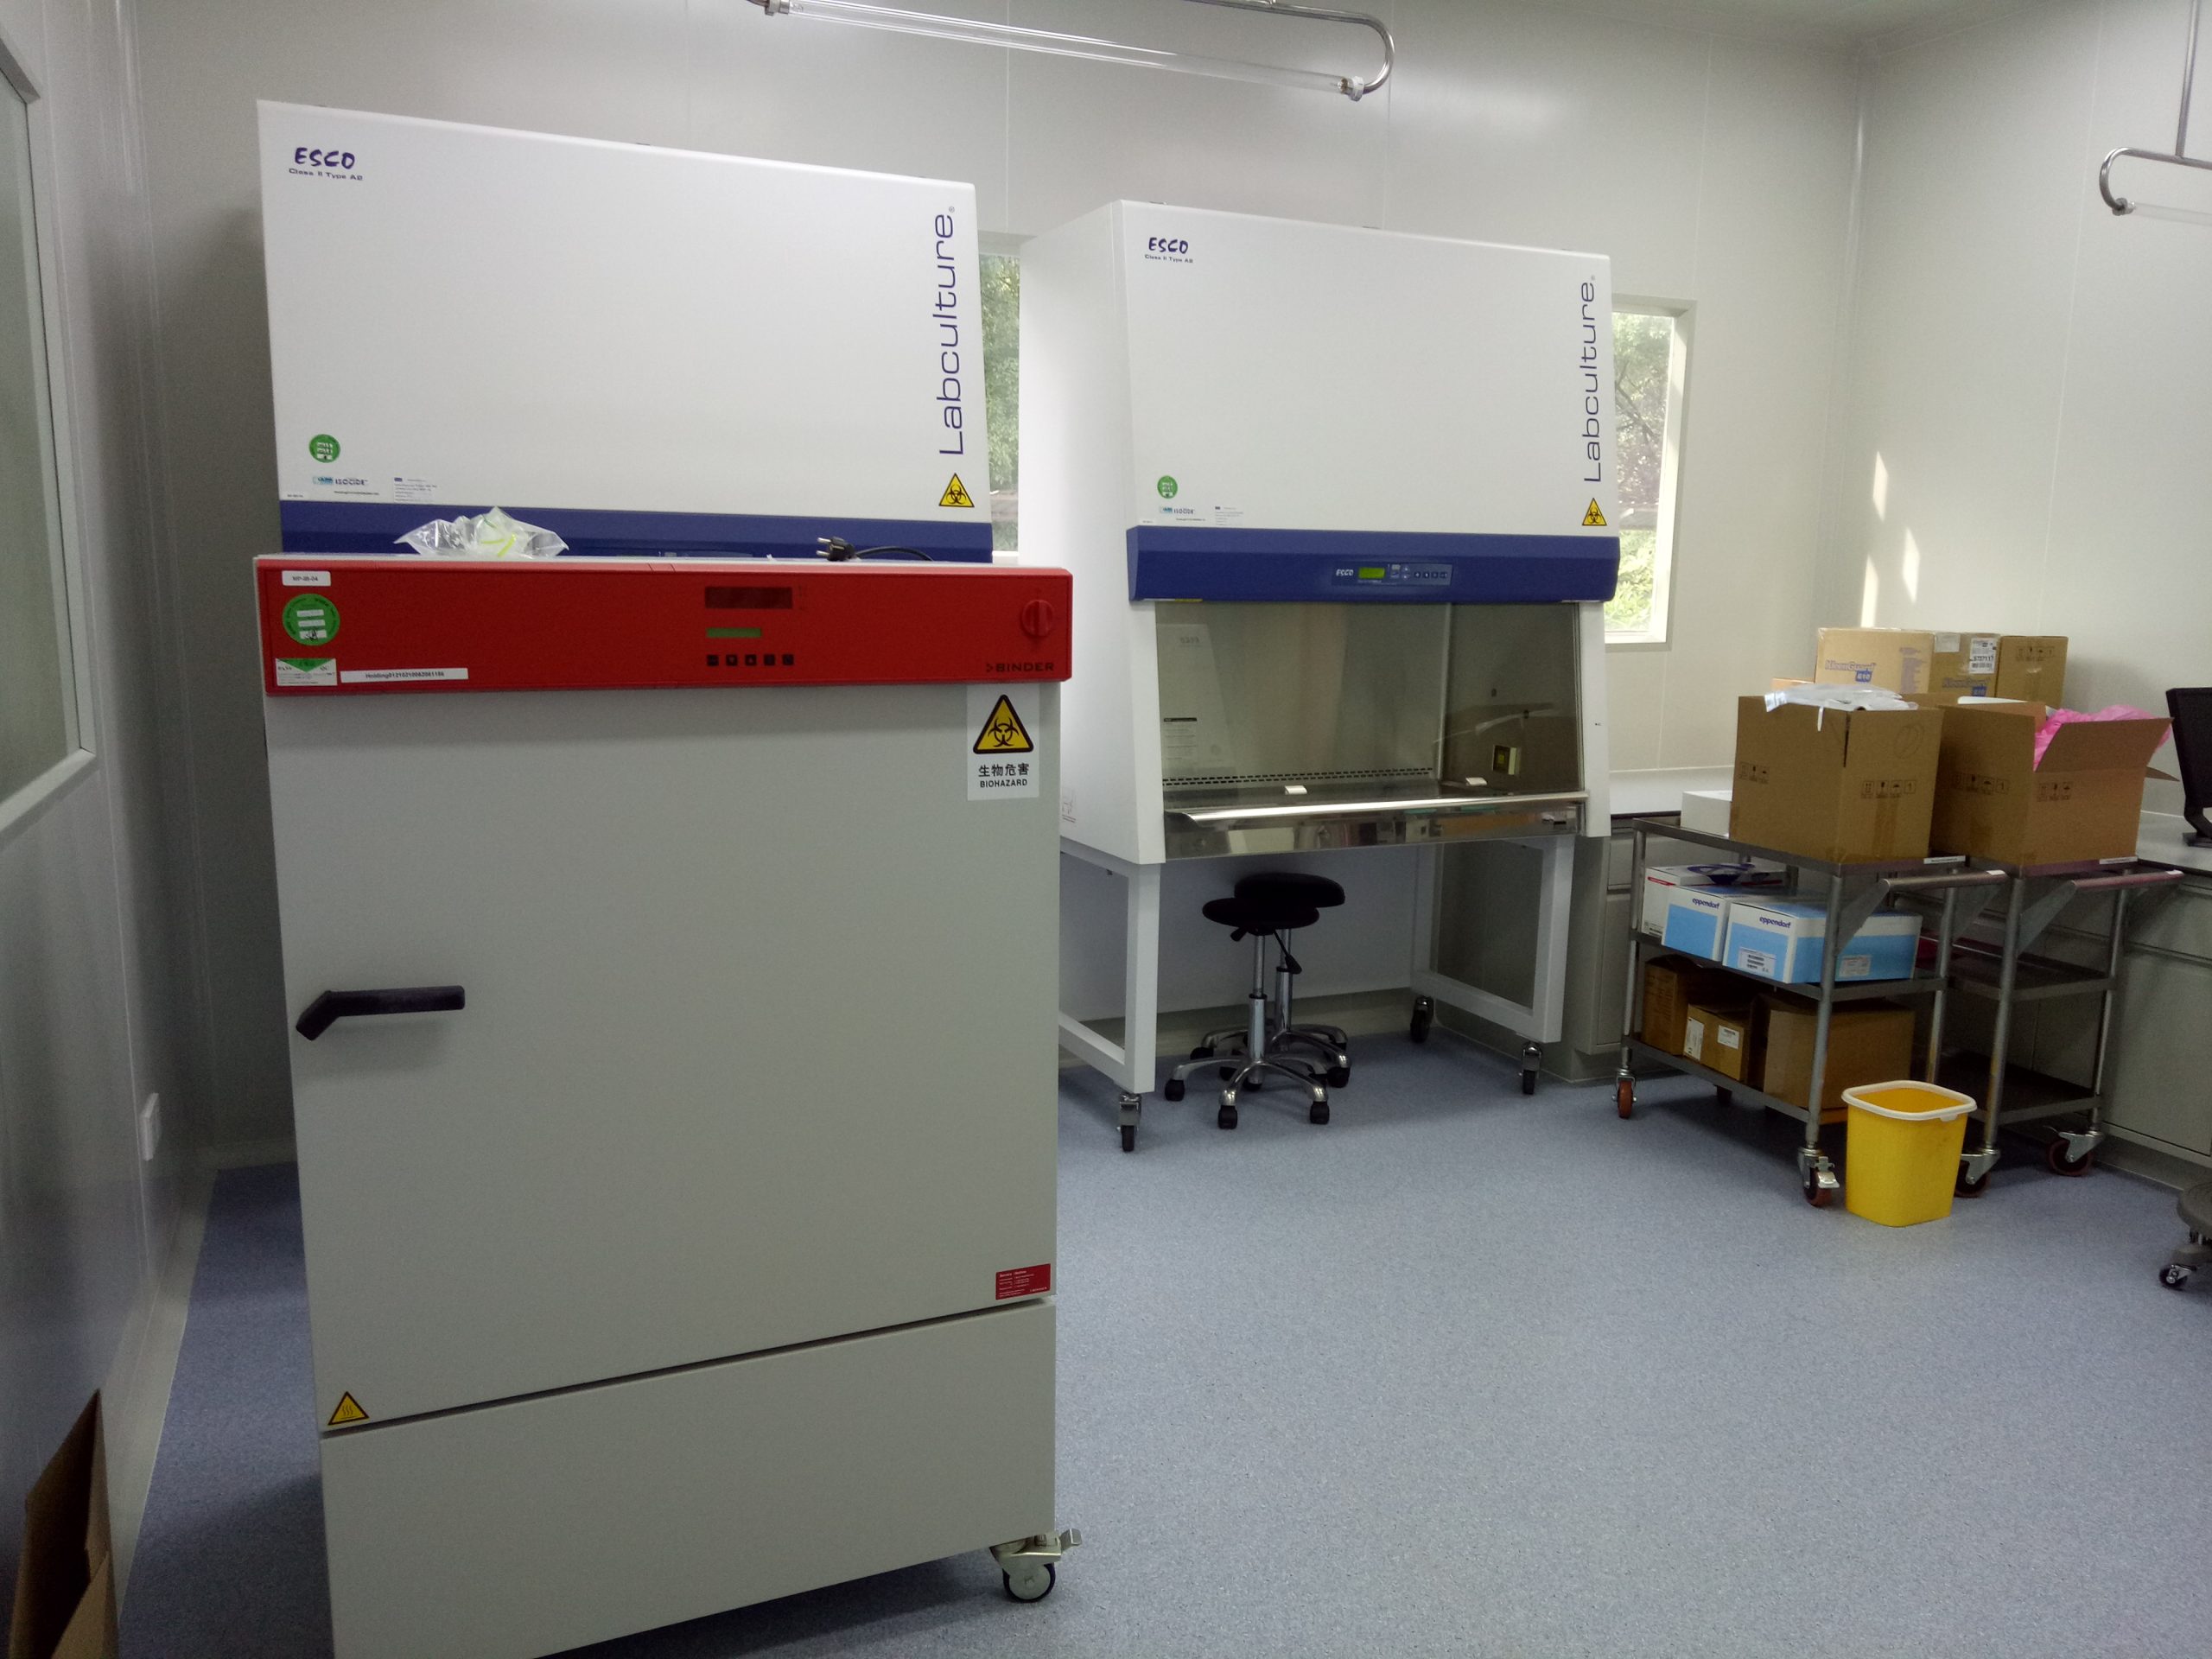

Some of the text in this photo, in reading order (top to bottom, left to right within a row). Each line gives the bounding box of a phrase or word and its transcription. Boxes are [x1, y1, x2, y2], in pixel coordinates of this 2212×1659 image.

[295, 147, 355, 169] ESCO
[289, 168, 315, 176] Class
[1148, 237, 1189, 254] ESCO
[933, 213, 963, 455] Labculture
[1580, 283, 1601, 482] Labculture
[995, 662, 1054, 672] BINDER
[978, 762, 1029, 777] 生物危害
[980, 779, 1027, 788] BIOHAZARD
[1693, 898, 1719, 909] eppendorf
[1759, 916, 1791, 928] eppendorf
